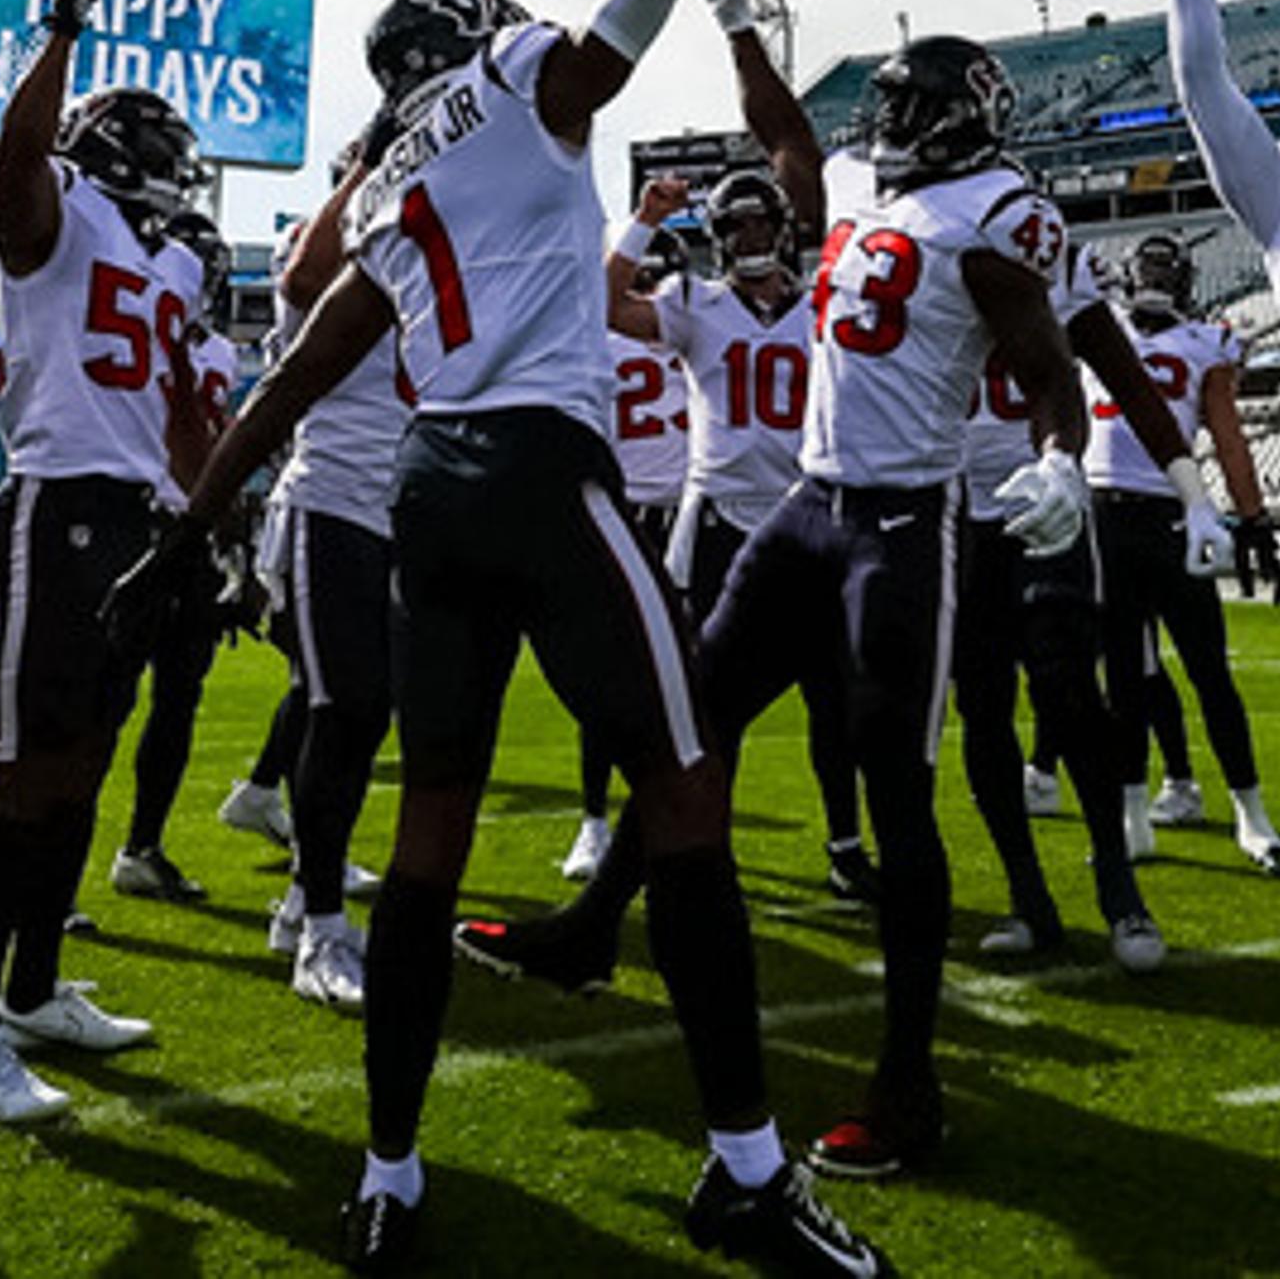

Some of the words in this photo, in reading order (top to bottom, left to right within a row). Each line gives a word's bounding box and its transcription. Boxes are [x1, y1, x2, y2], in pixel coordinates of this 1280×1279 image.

[443, 83, 485, 143] JR
[399, 178, 473, 354] 1
[1012, 213, 1063, 267] 43
[723, 339, 808, 431] 10
